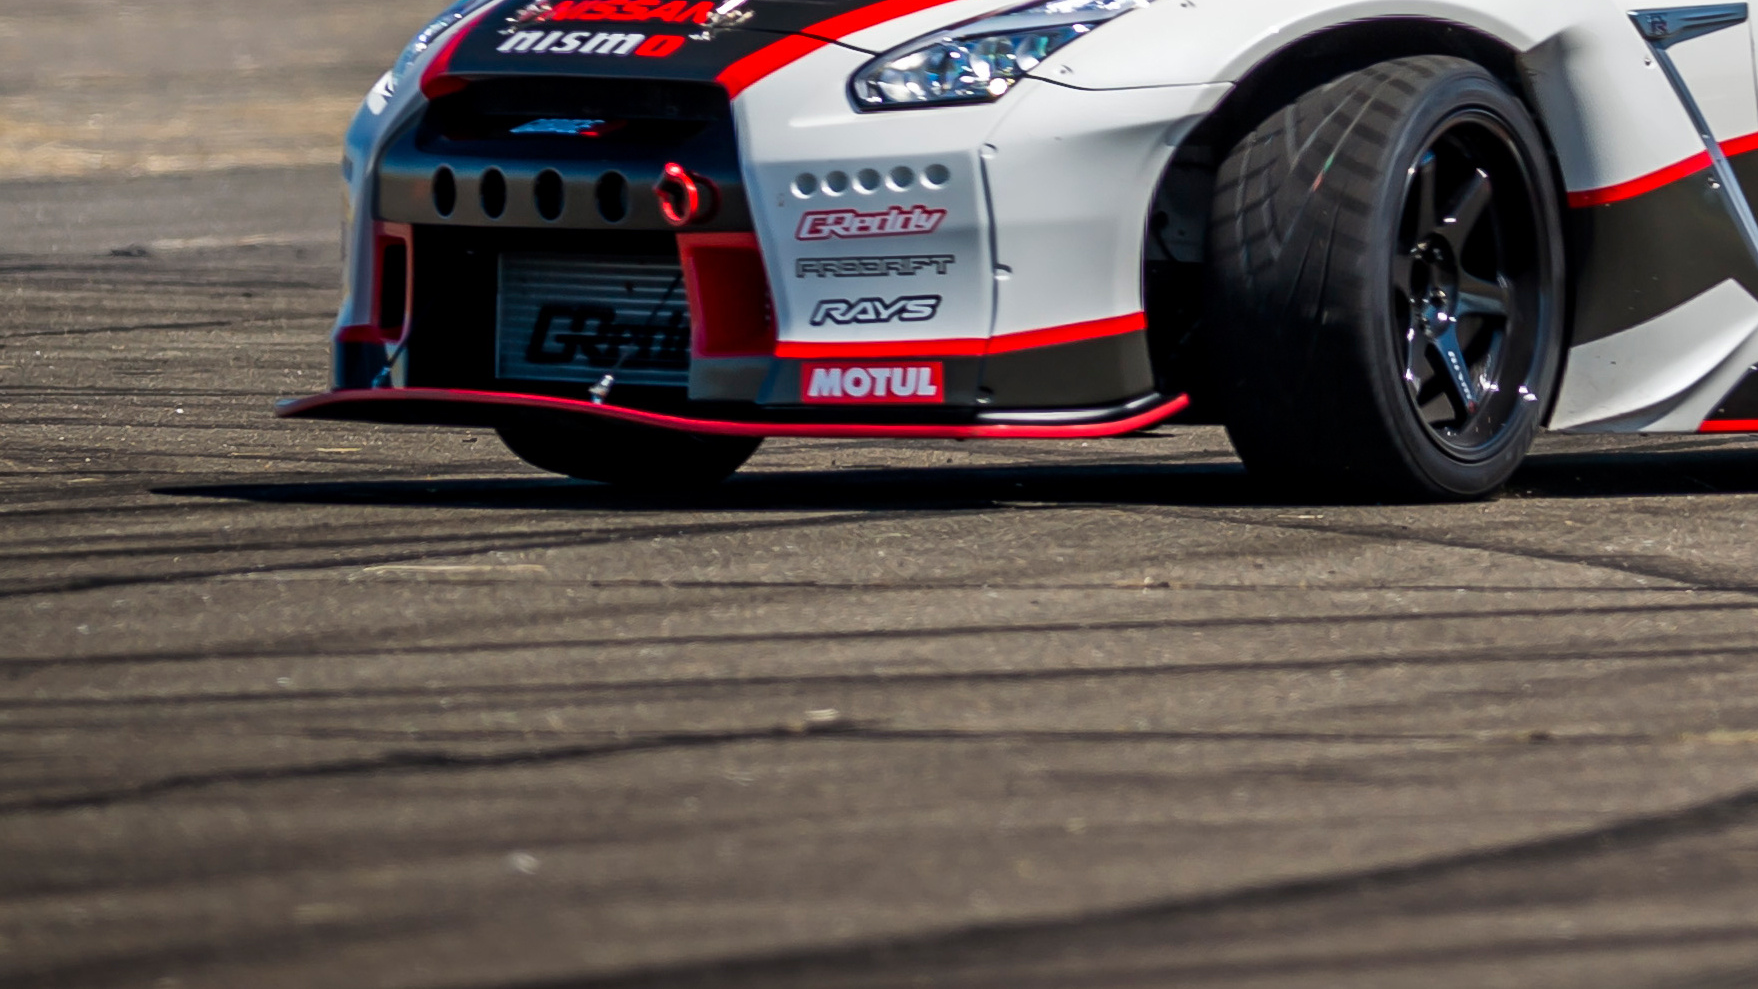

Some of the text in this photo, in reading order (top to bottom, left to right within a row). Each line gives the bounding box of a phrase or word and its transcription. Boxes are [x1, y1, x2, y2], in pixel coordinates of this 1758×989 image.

[795, 205, 947, 241] GReddy
[810, 294, 942, 327] RAYS
[807, 367, 937, 397] MOTUL
